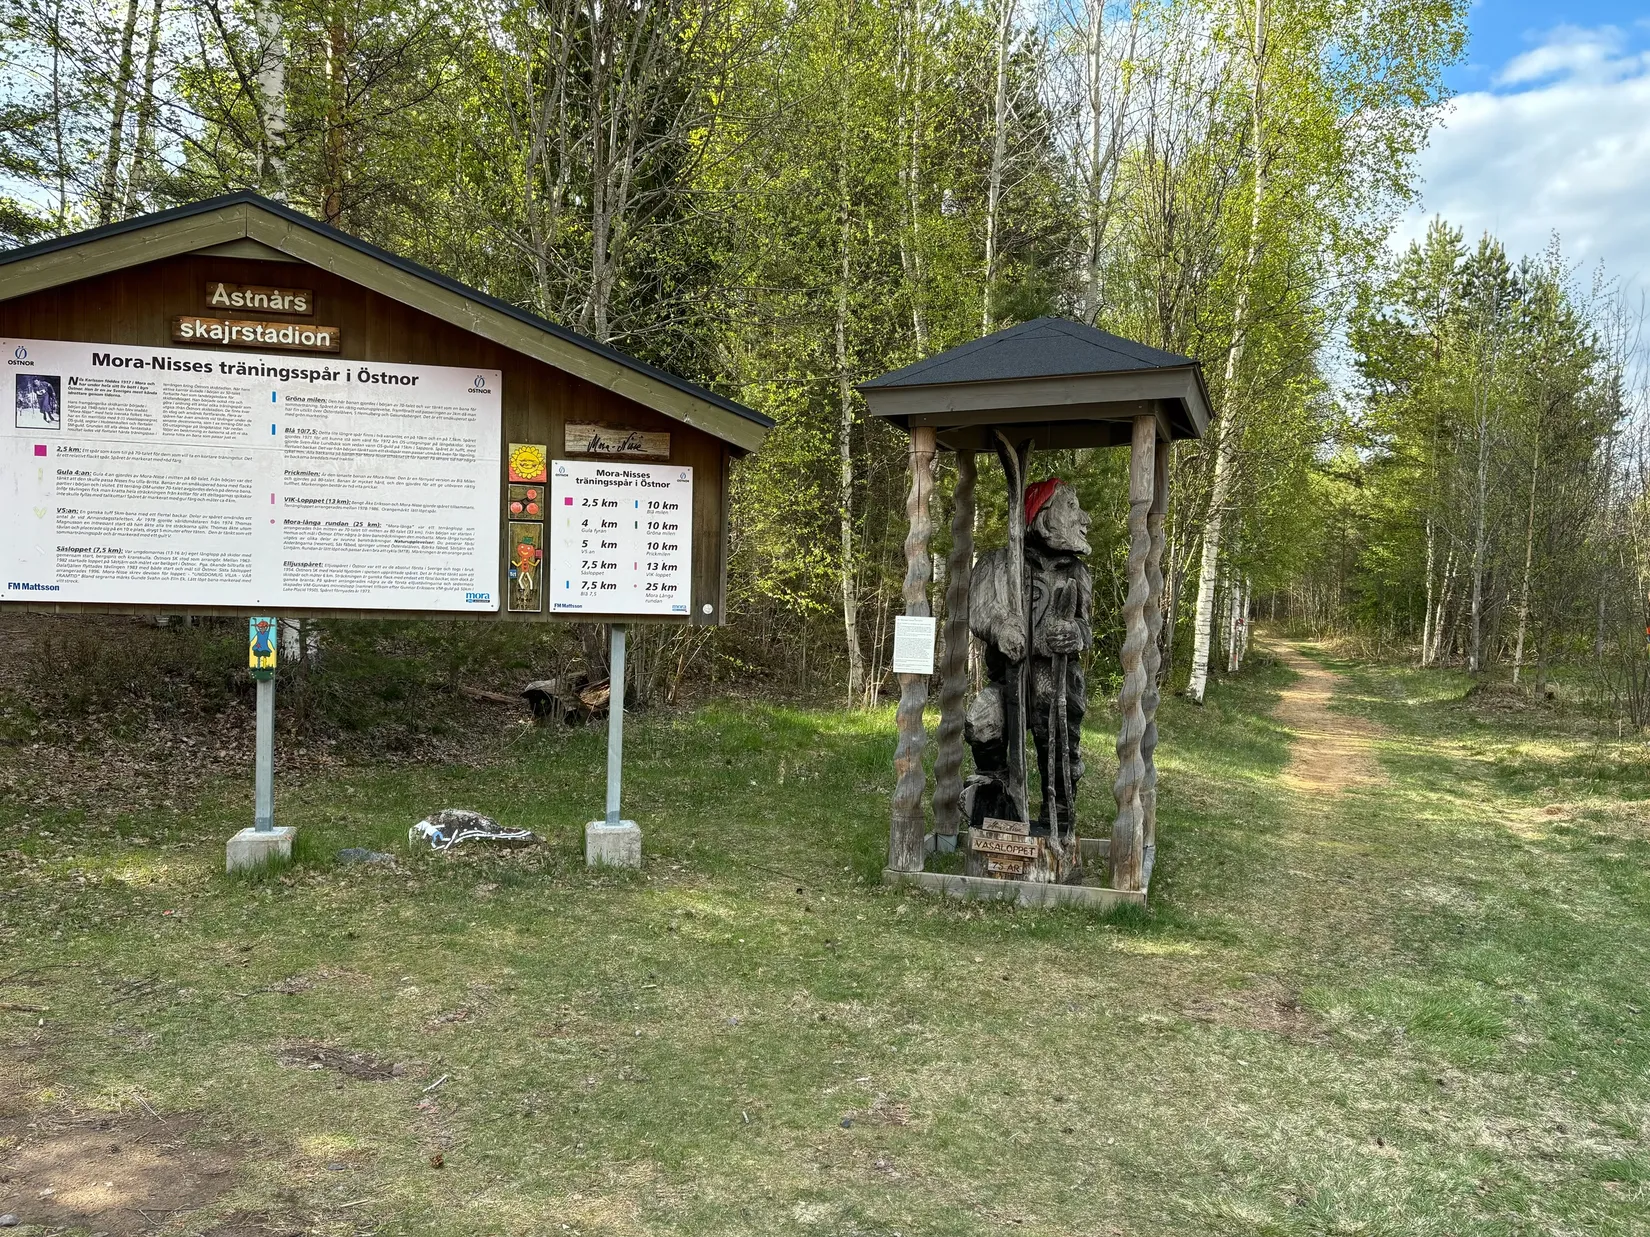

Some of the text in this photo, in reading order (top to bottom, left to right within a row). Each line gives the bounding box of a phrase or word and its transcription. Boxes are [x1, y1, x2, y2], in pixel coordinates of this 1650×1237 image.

[212, 283, 306, 311] Åstnårs
[181, 320, 330, 346] skajrstadion
[92, 352, 419, 386] Mora-Nisses träningsspår i Östnor
[596, 470, 650, 478] Mora-Nisses
[576, 478, 632, 487] träningsspår
[640, 479, 670, 488] Östnor
[582, 498, 618, 508] 2,5 km
[648, 501, 678, 510] 10 km
[601, 520, 617, 528] km
[648, 522, 678, 530] 10 km
[601, 540, 617, 549] km
[662, 542, 678, 550] km
[582, 561, 617, 570] 7,5 km
[661, 563, 677, 571] km
[22, 583, 60, 591] Mattsson
[581, 581, 616, 590] 7,5 km
[661, 583, 677, 591] km
[975, 840, 1035, 856] VASALOPPET
[992, 862, 1004, 870] 75
